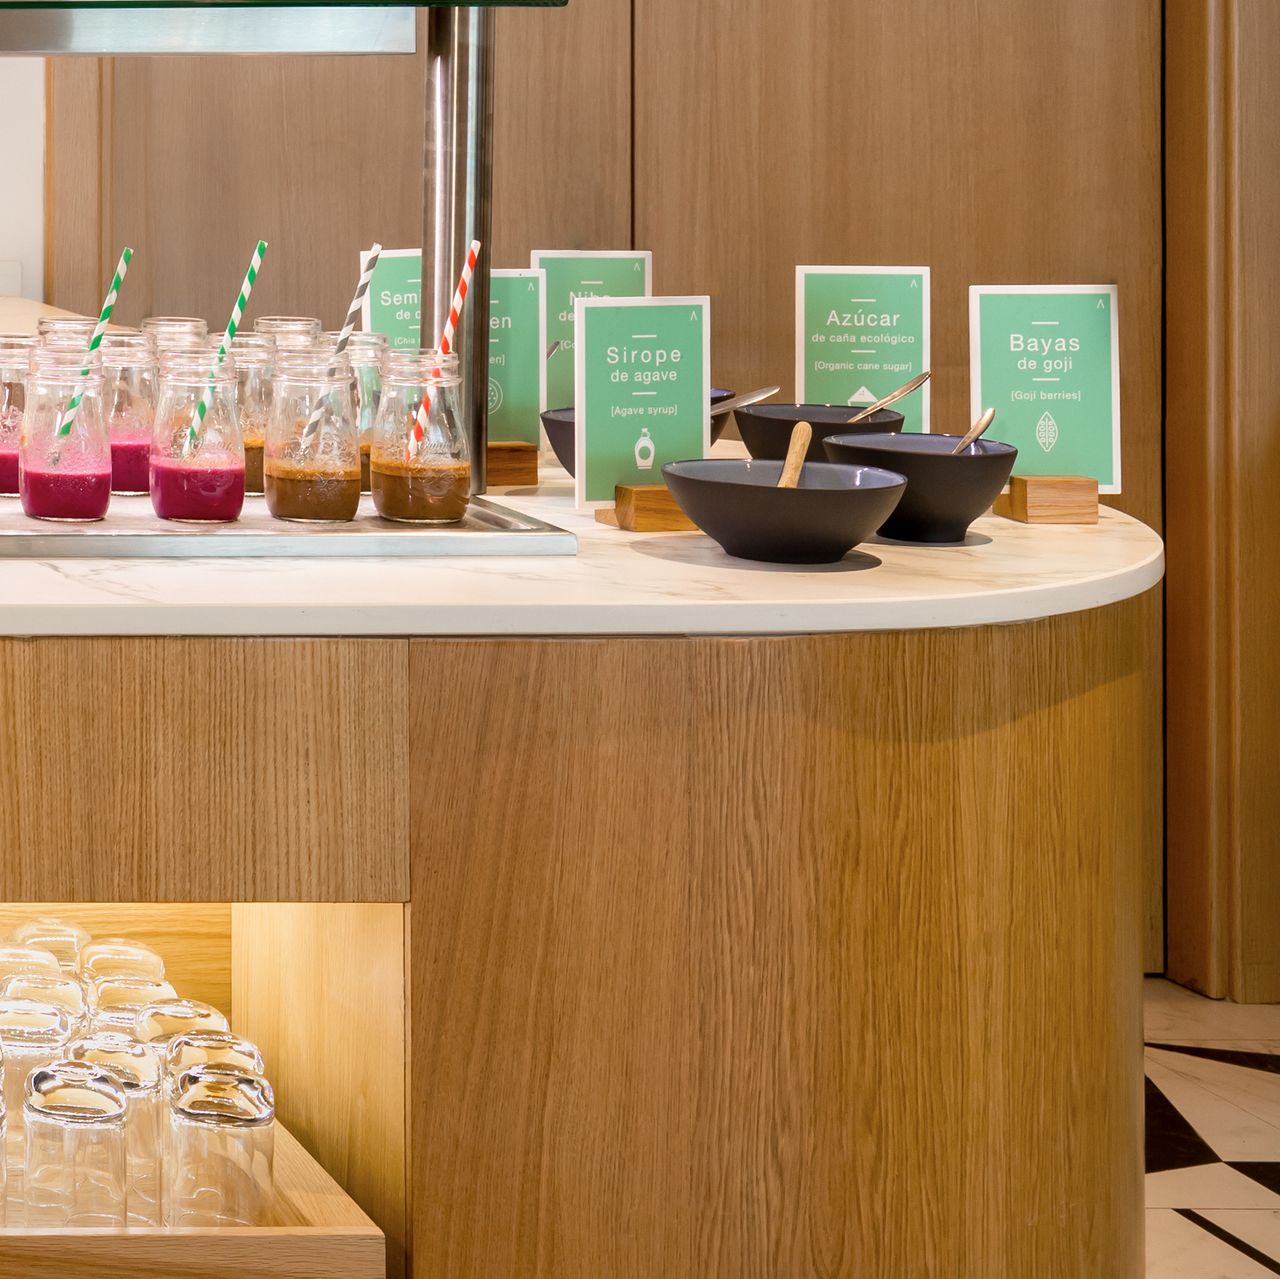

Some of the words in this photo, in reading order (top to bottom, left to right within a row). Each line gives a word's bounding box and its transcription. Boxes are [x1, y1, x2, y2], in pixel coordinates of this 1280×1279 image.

[396, 310, 410, 320] de
[558, 311, 575, 321] de
[826, 309, 900, 326] Azúcar
[812, 334, 825, 342] de
[829, 334, 856, 342] caña
[861, 334, 915, 345] ecológico
[1010, 334, 1080, 355] Bayas
[607, 347, 681, 366] Sirope
[815, 361, 854, 371] [Organic
[883, 362, 912, 372] sugar]
[1017, 357, 1037, 370] de
[1043, 357, 1072, 373] goji
[611, 370, 628, 382] de
[634, 370, 677, 384] agave
[1011, 390, 1036, 401] [Goji
[1040, 391, 1081, 401] berries]
[611, 406, 644, 417] [Agave
[647, 405, 677, 416] syrup]
